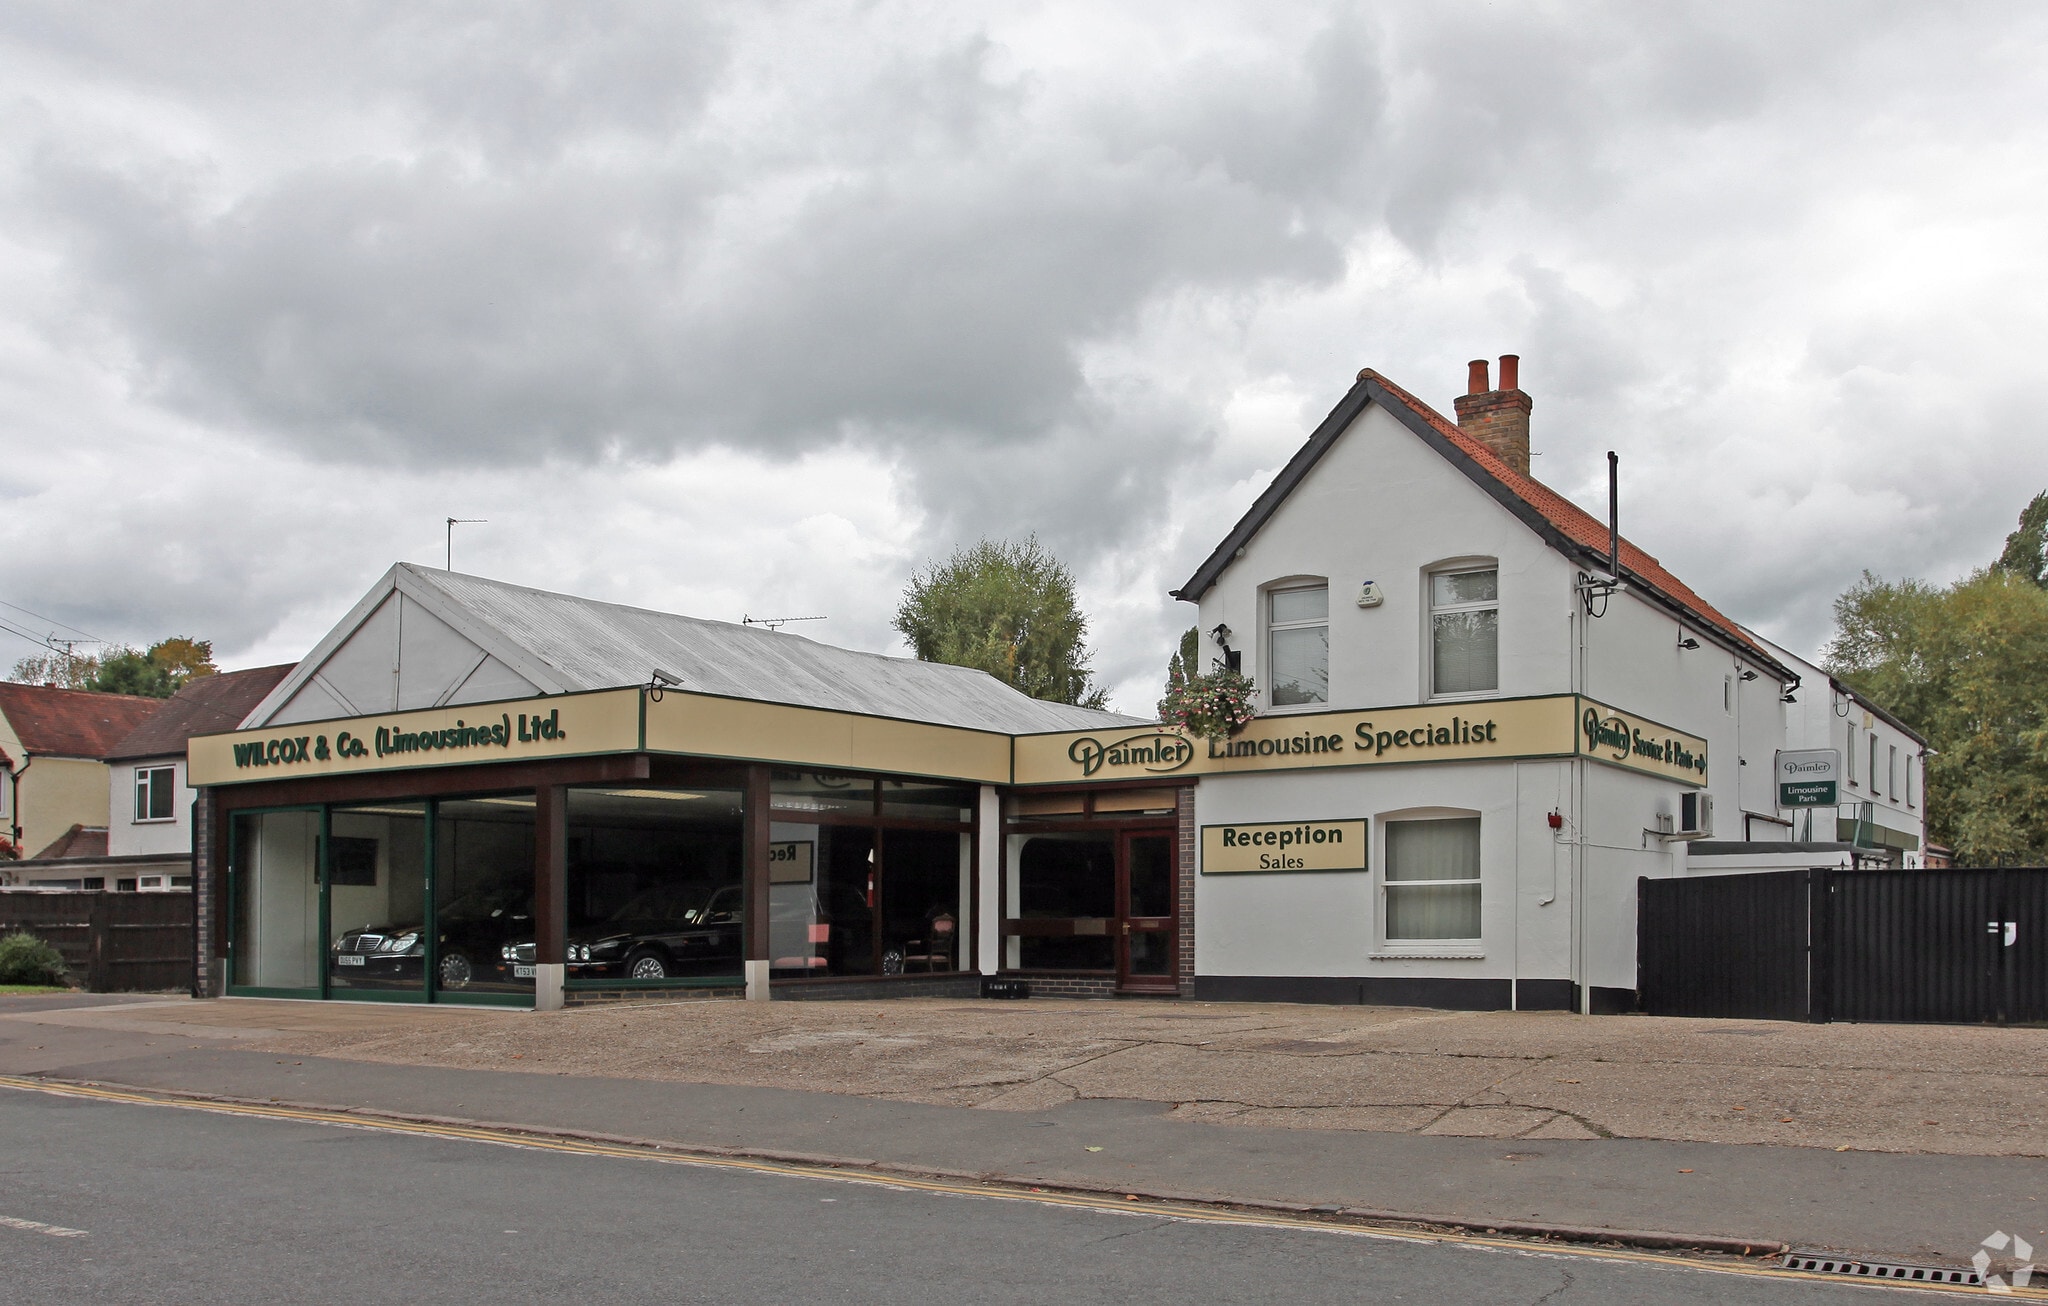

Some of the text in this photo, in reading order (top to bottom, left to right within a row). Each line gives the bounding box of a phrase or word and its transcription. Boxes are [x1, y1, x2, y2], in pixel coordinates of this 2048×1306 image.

[233, 709, 566, 767] WILCOX & Co. (Limousines) Ltd.
[1068, 717, 1497, 777] Daimler Limousine Specialist
[1583, 707, 1693, 769] Daimler Service & Parts
[1784, 761, 1831, 774] Daimler
[1787, 785, 1829, 794] Limousine
[1223, 825, 1343, 850] Reception
[1259, 853, 1304, 870] Sales
